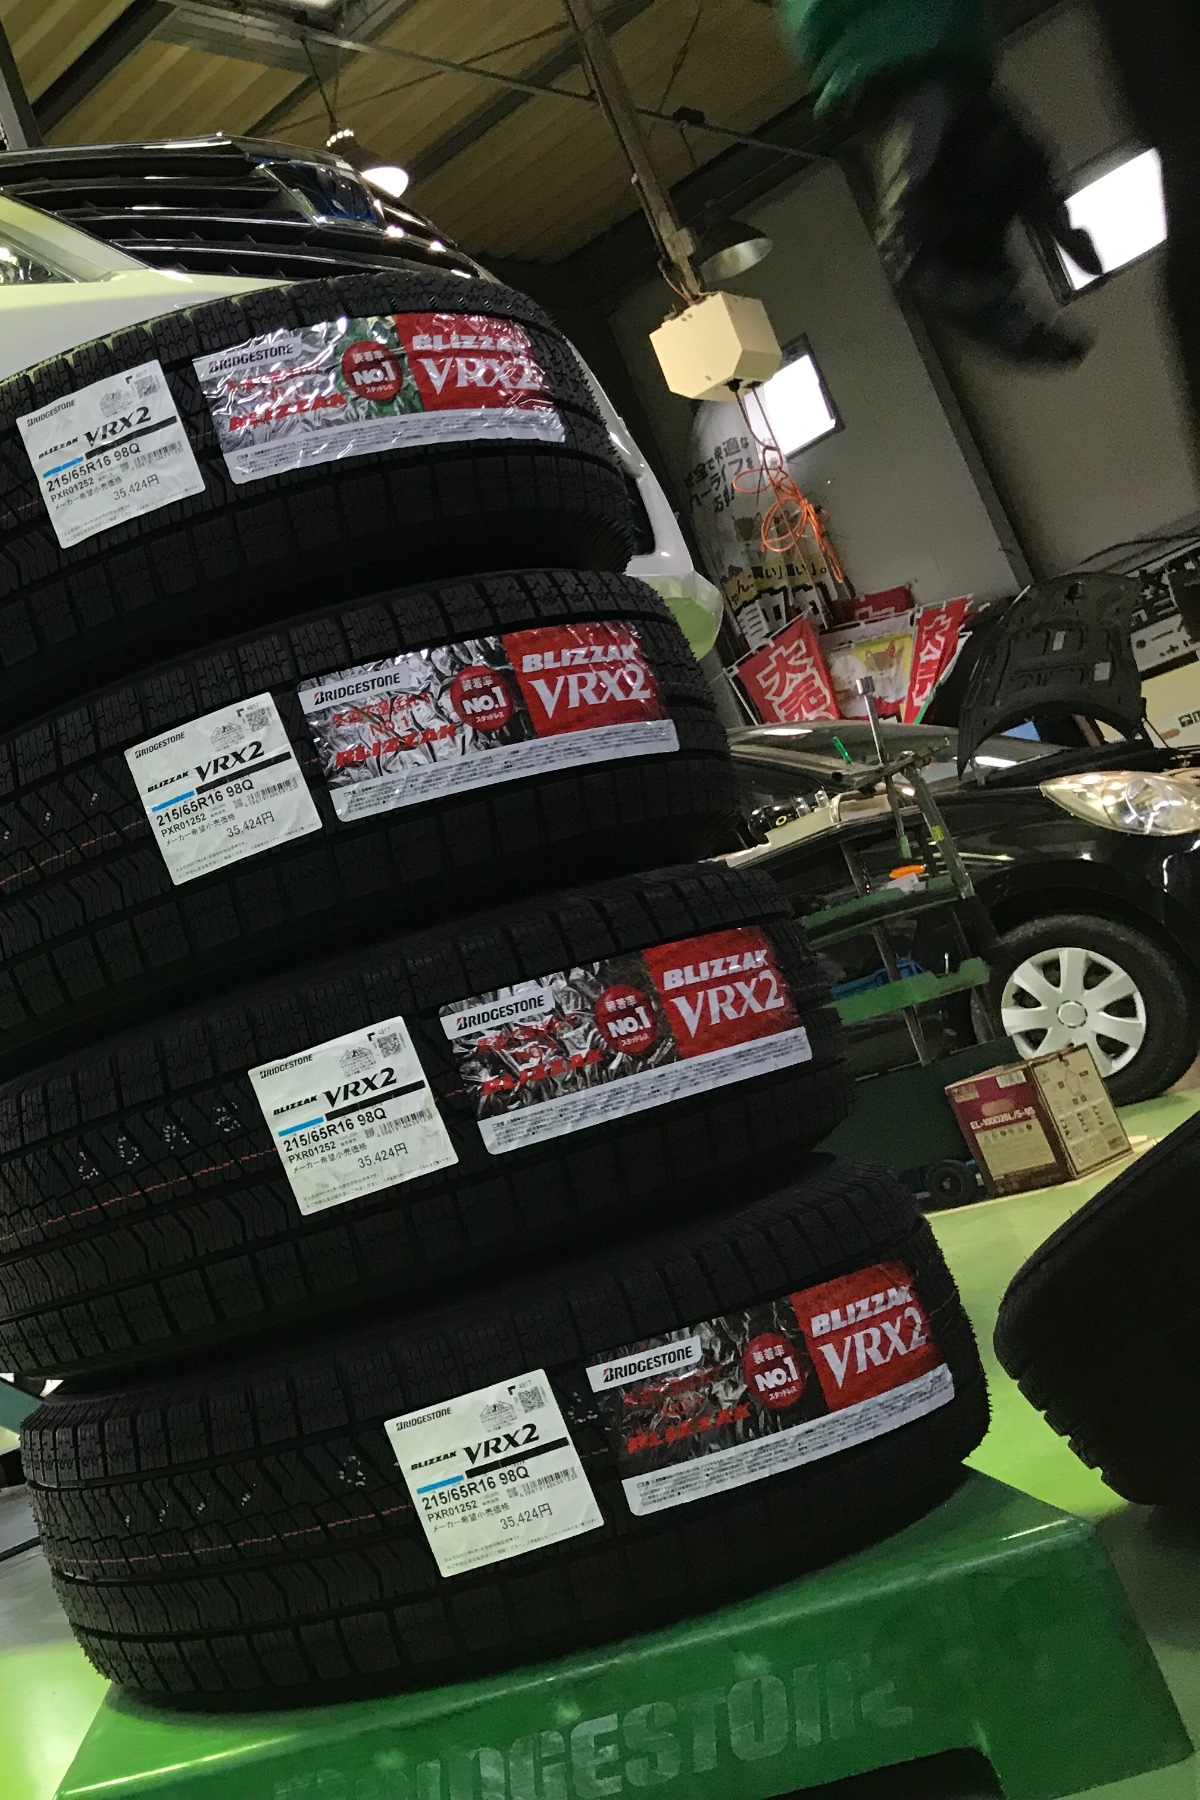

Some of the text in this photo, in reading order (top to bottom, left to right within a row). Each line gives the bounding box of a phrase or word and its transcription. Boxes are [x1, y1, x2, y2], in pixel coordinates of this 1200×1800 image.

[209, 343, 294, 373] BRIDGESTONE
[352, 362, 398, 384] NO.1
[416, 357, 540, 395] VRX2
[27, 399, 76, 427] BRIDGESTONE
[38, 406, 152, 459] BLIZZAK VRX2
[46, 457, 112, 492] 215/65R16
[114, 442, 141, 462] 98Q
[50, 477, 94, 502] PXR01252
[522, 644, 636, 673] BLIZZAK
[314, 672, 400, 706] BRIDGESTONE
[462, 686, 507, 716] NO.1
[529, 663, 651, 719] VRX2
[135, 732, 186, 758] BRIDGESTONE
[335, 723, 458, 768] BLIZZAK
[148, 740, 265, 792] BLIZZAK VRX2
[156, 789, 224, 826] 215/65R16
[226, 778, 255, 797] 98Q
[161, 812, 206, 838] PXR01252
[663, 948, 768, 990] BLIZZAK
[456, 994, 544, 1031] BRIDGESTONE
[606, 1007, 652, 1038] NO.1
[669, 970, 785, 1039] VRX2
[260, 1054, 313, 1080] BRIDGESTONE
[273, 1067, 398, 1116] BLIZZAK VRX2
[283, 1118, 354, 1152] 215/65R16
[357, 1108, 387, 1126] 98Q
[288, 1141, 336, 1164] PXR01252
[810, 1284, 914, 1338] BLIZZAK
[603, 1345, 694, 1384] BRIDGESTONE
[818, 1307, 928, 1390] VRX2
[754, 1357, 798, 1392] NO.1
[396, 1406, 451, 1431] BRIDGESTONE
[411, 1423, 540, 1470] BLIZZAK VRX2
[422, 1477, 496, 1510] 215/65R16
[500, 1465, 530, 1486] 98Q
[427, 1500, 478, 1522] PXR01252
